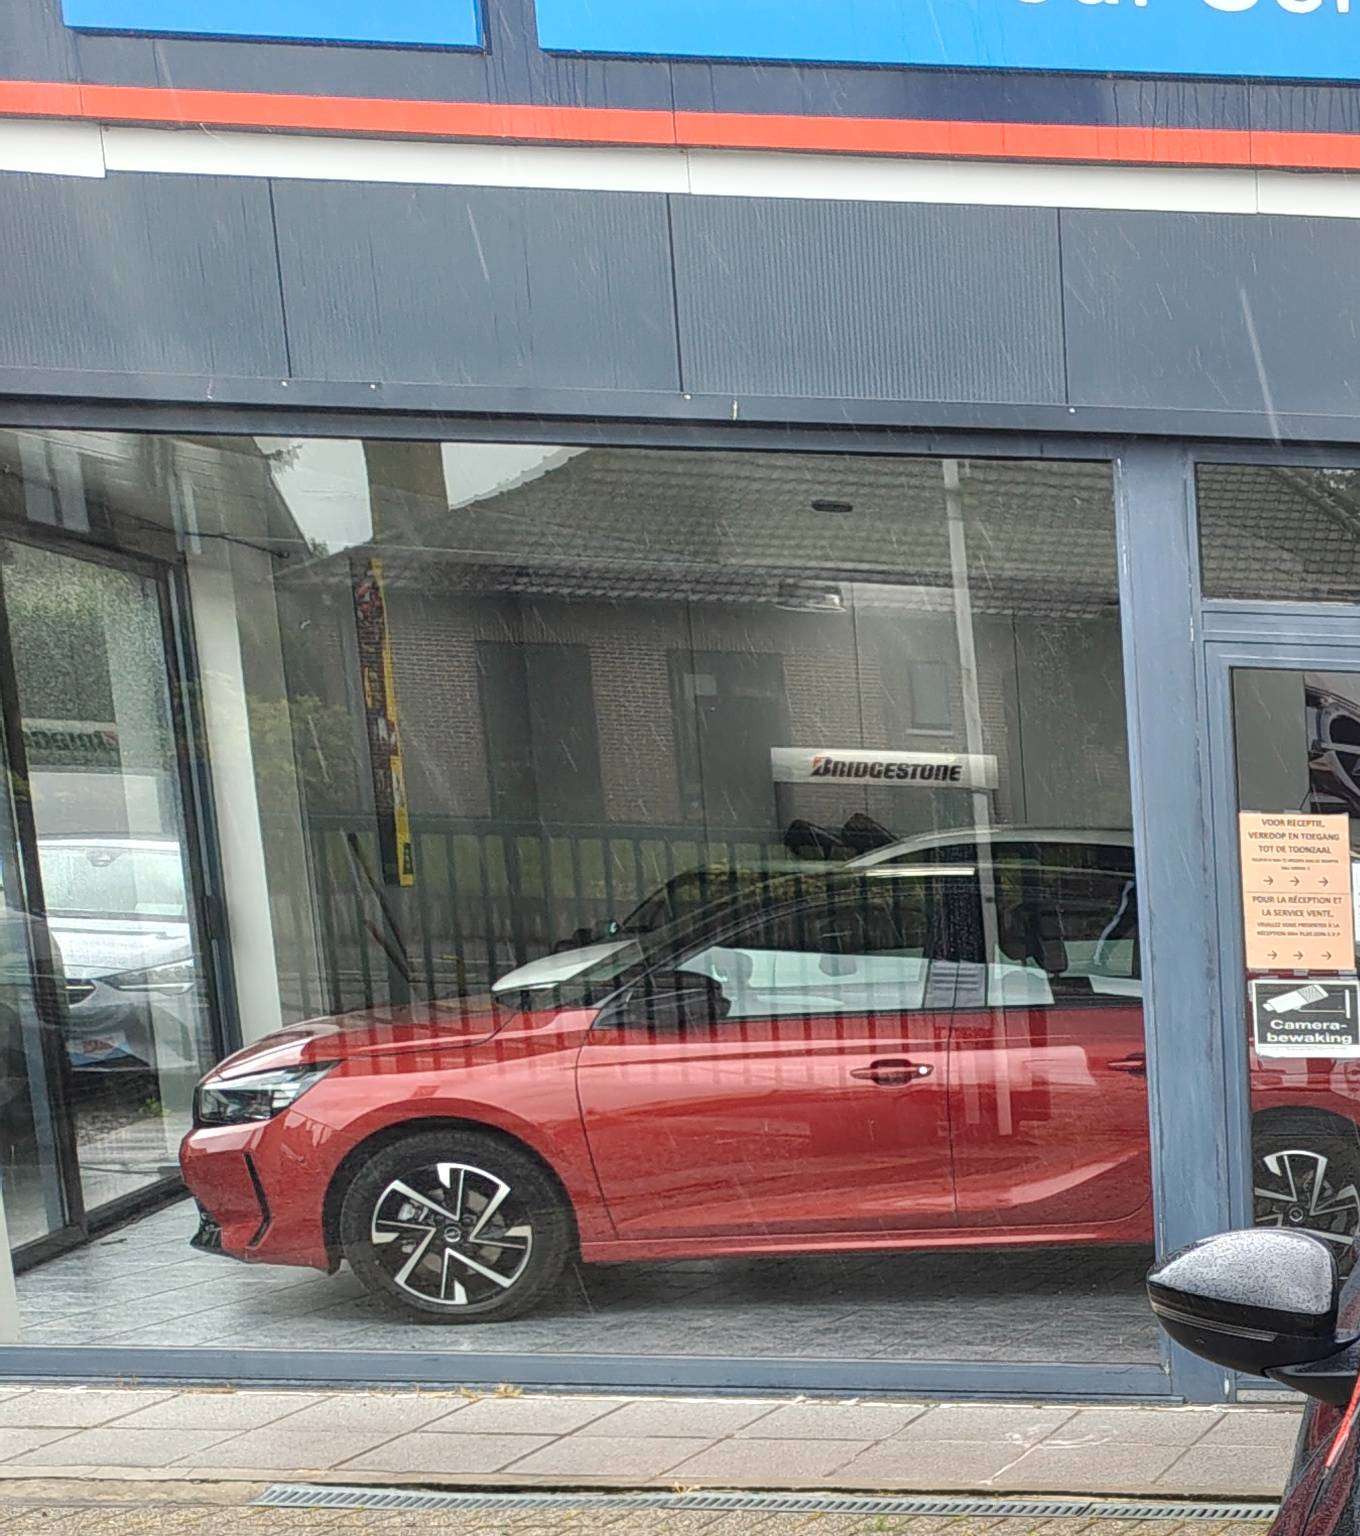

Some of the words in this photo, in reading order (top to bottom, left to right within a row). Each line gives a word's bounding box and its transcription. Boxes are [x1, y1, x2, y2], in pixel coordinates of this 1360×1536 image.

[811, 756, 963, 782] BRIDGESTONE
[1270, 1019, 1348, 1030] Camera-
[1266, 1031, 1353, 1045] bewaking
